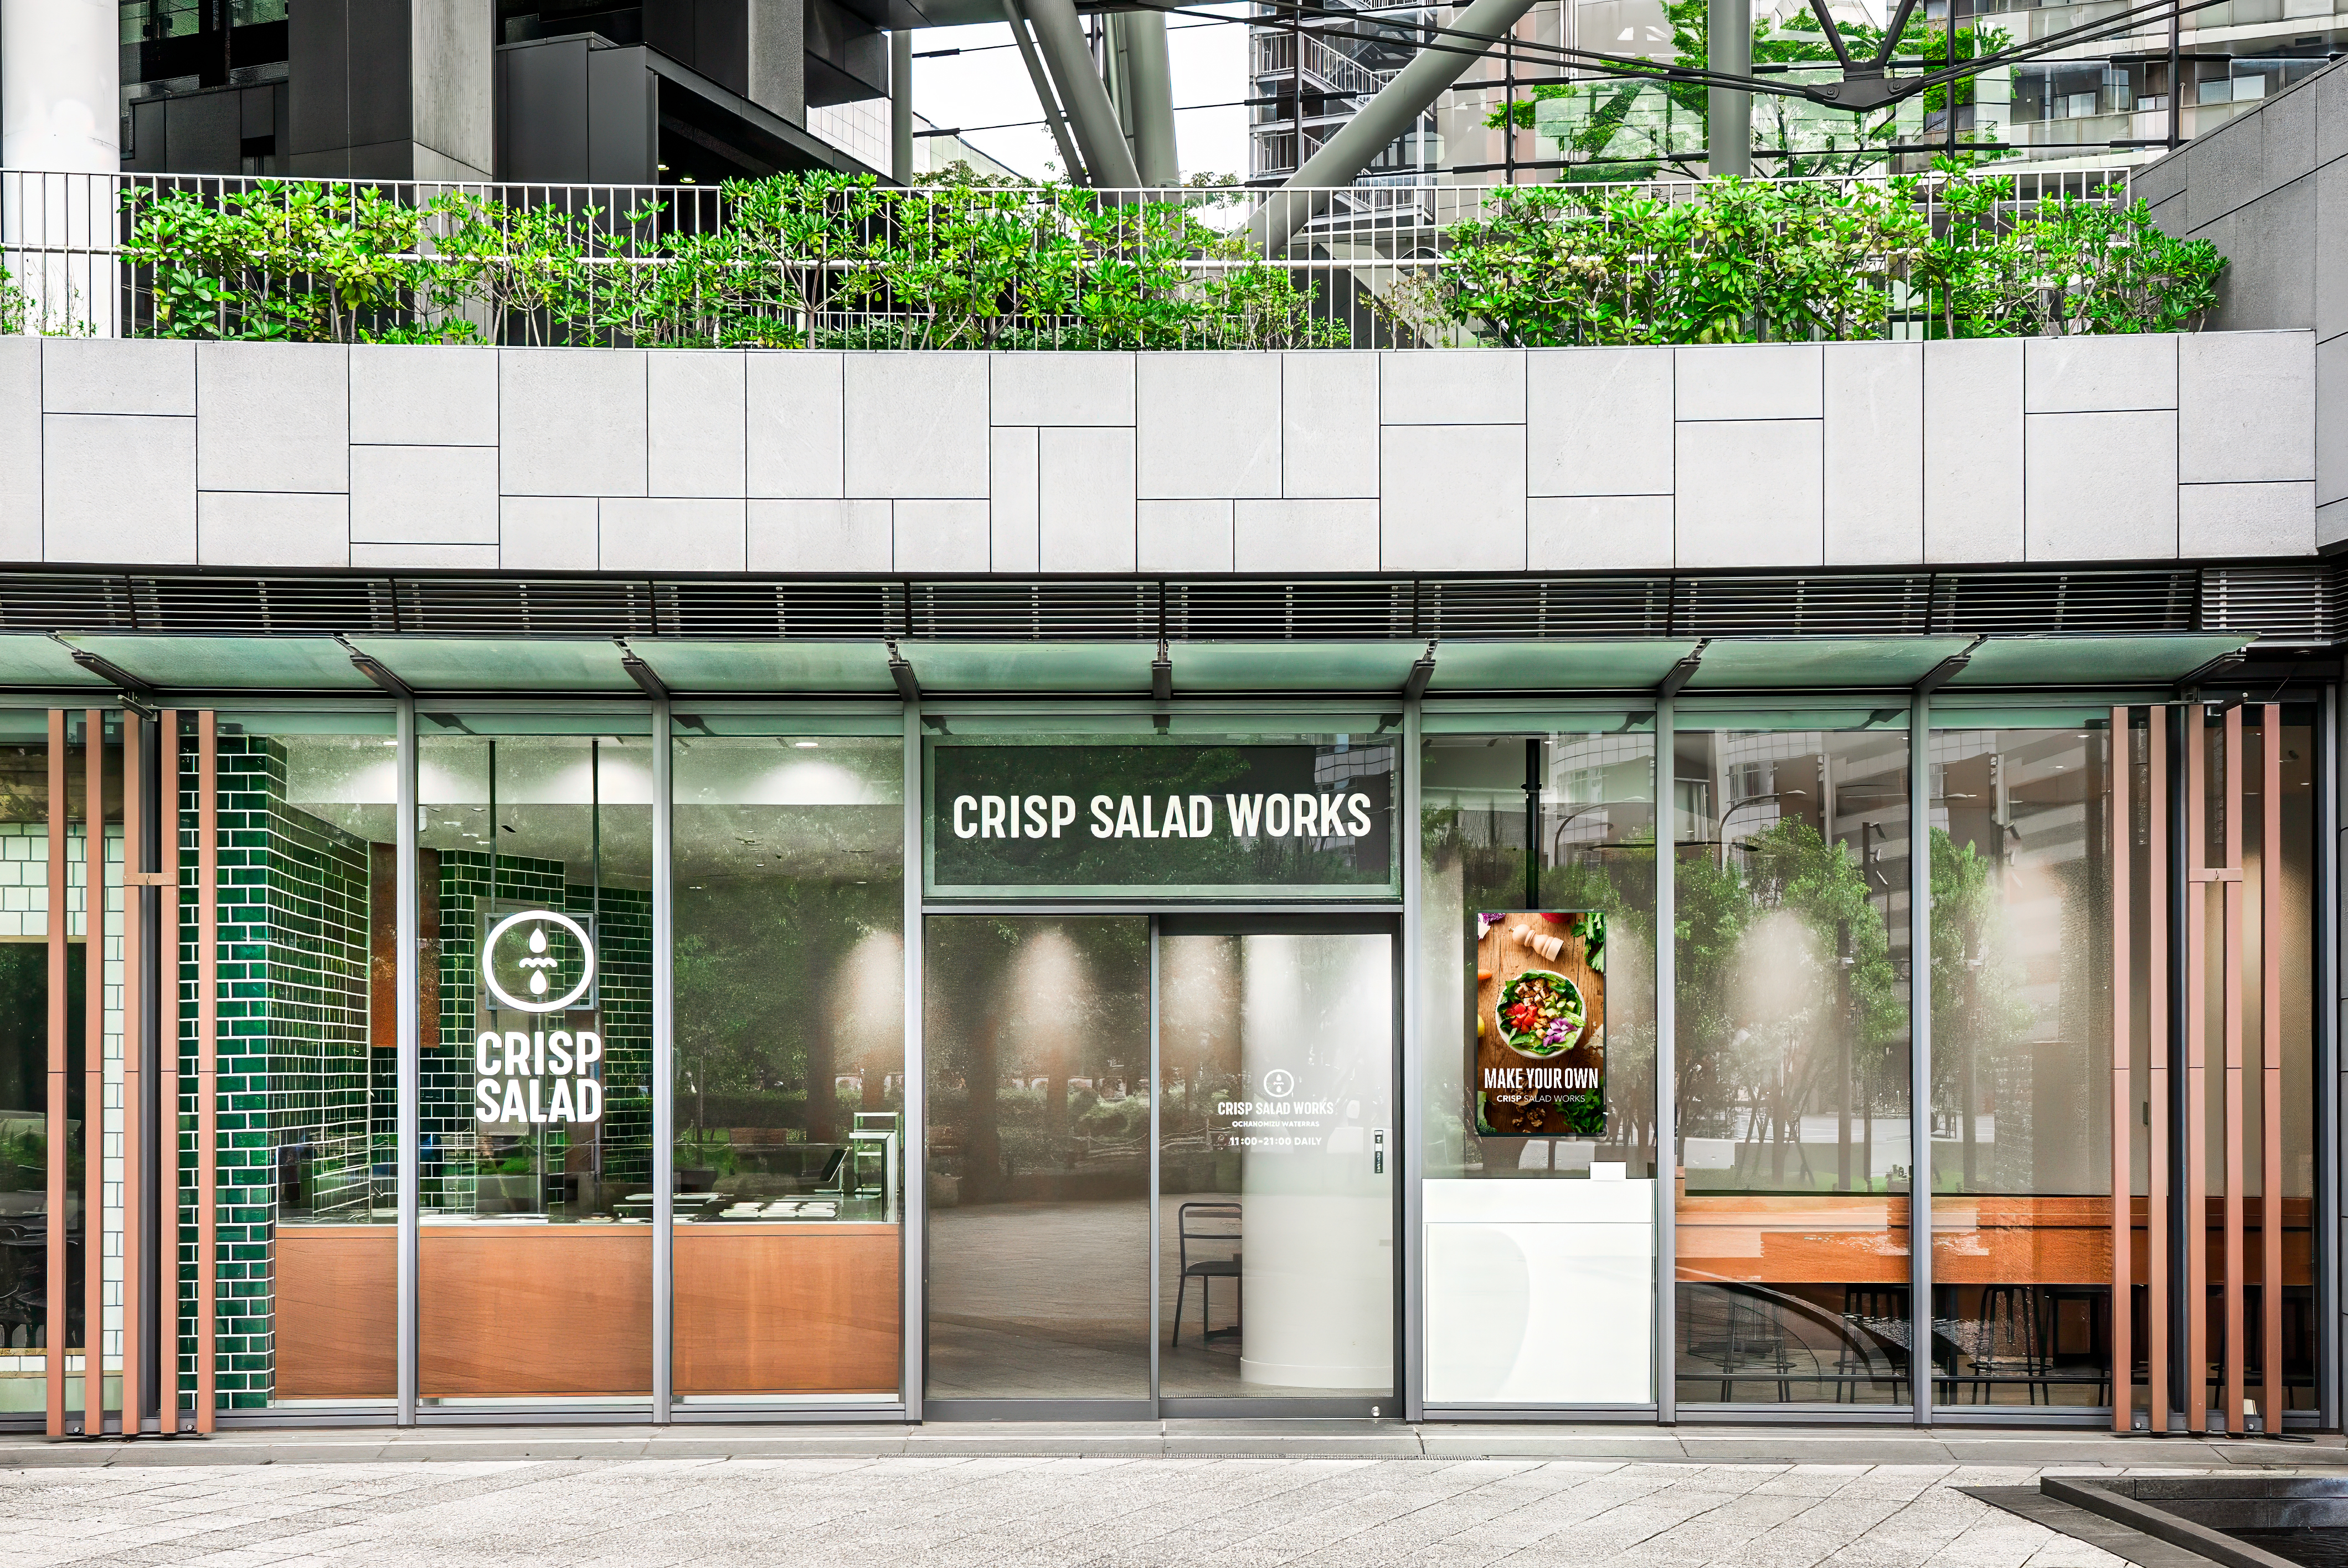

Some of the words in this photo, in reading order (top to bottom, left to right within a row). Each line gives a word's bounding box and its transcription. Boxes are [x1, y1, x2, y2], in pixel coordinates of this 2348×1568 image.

[953, 795, 1076, 839] CRISP
[1090, 795, 1213, 839] SALAD
[1226, 793, 1371, 838] WORKS
[476, 1030, 602, 1076] CRISP
[1484, 1067, 1523, 1089] MAKE
[1526, 1067, 1563, 1089] YOUR
[1564, 1067, 1598, 1089] OWN
[476, 1077, 602, 1123] SALAD
[1218, 1102, 1253, 1115] CRISP
[1255, 1102, 1290, 1115] SALAD
[1293, 1101, 1334, 1115] WORKS
[1229, 1137, 1291, 1146] 11:00-21:00
[1294, 1137, 1322, 1146] DAILY
